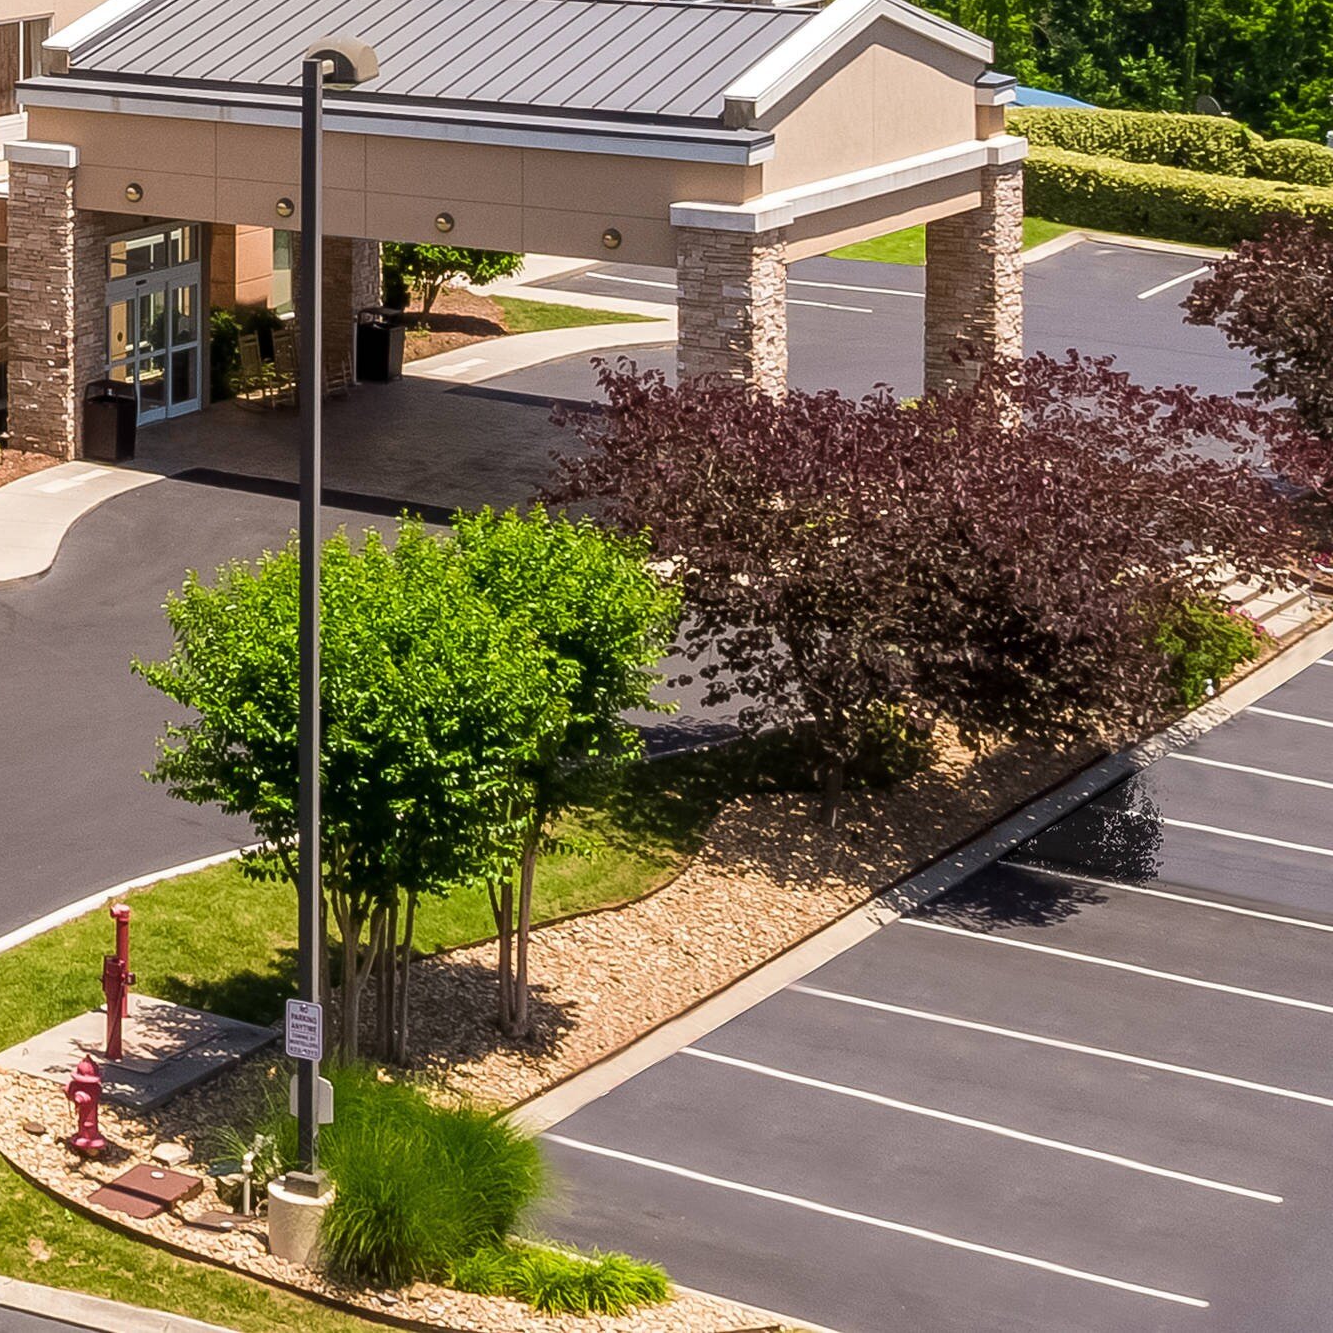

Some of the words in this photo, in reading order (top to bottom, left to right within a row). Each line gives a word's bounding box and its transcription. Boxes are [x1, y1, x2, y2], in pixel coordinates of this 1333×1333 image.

[300, 1005, 309, 1013] NO
[291, 1013, 317, 1024] PARKING
[291, 1022, 316, 1032] ANYTIME
